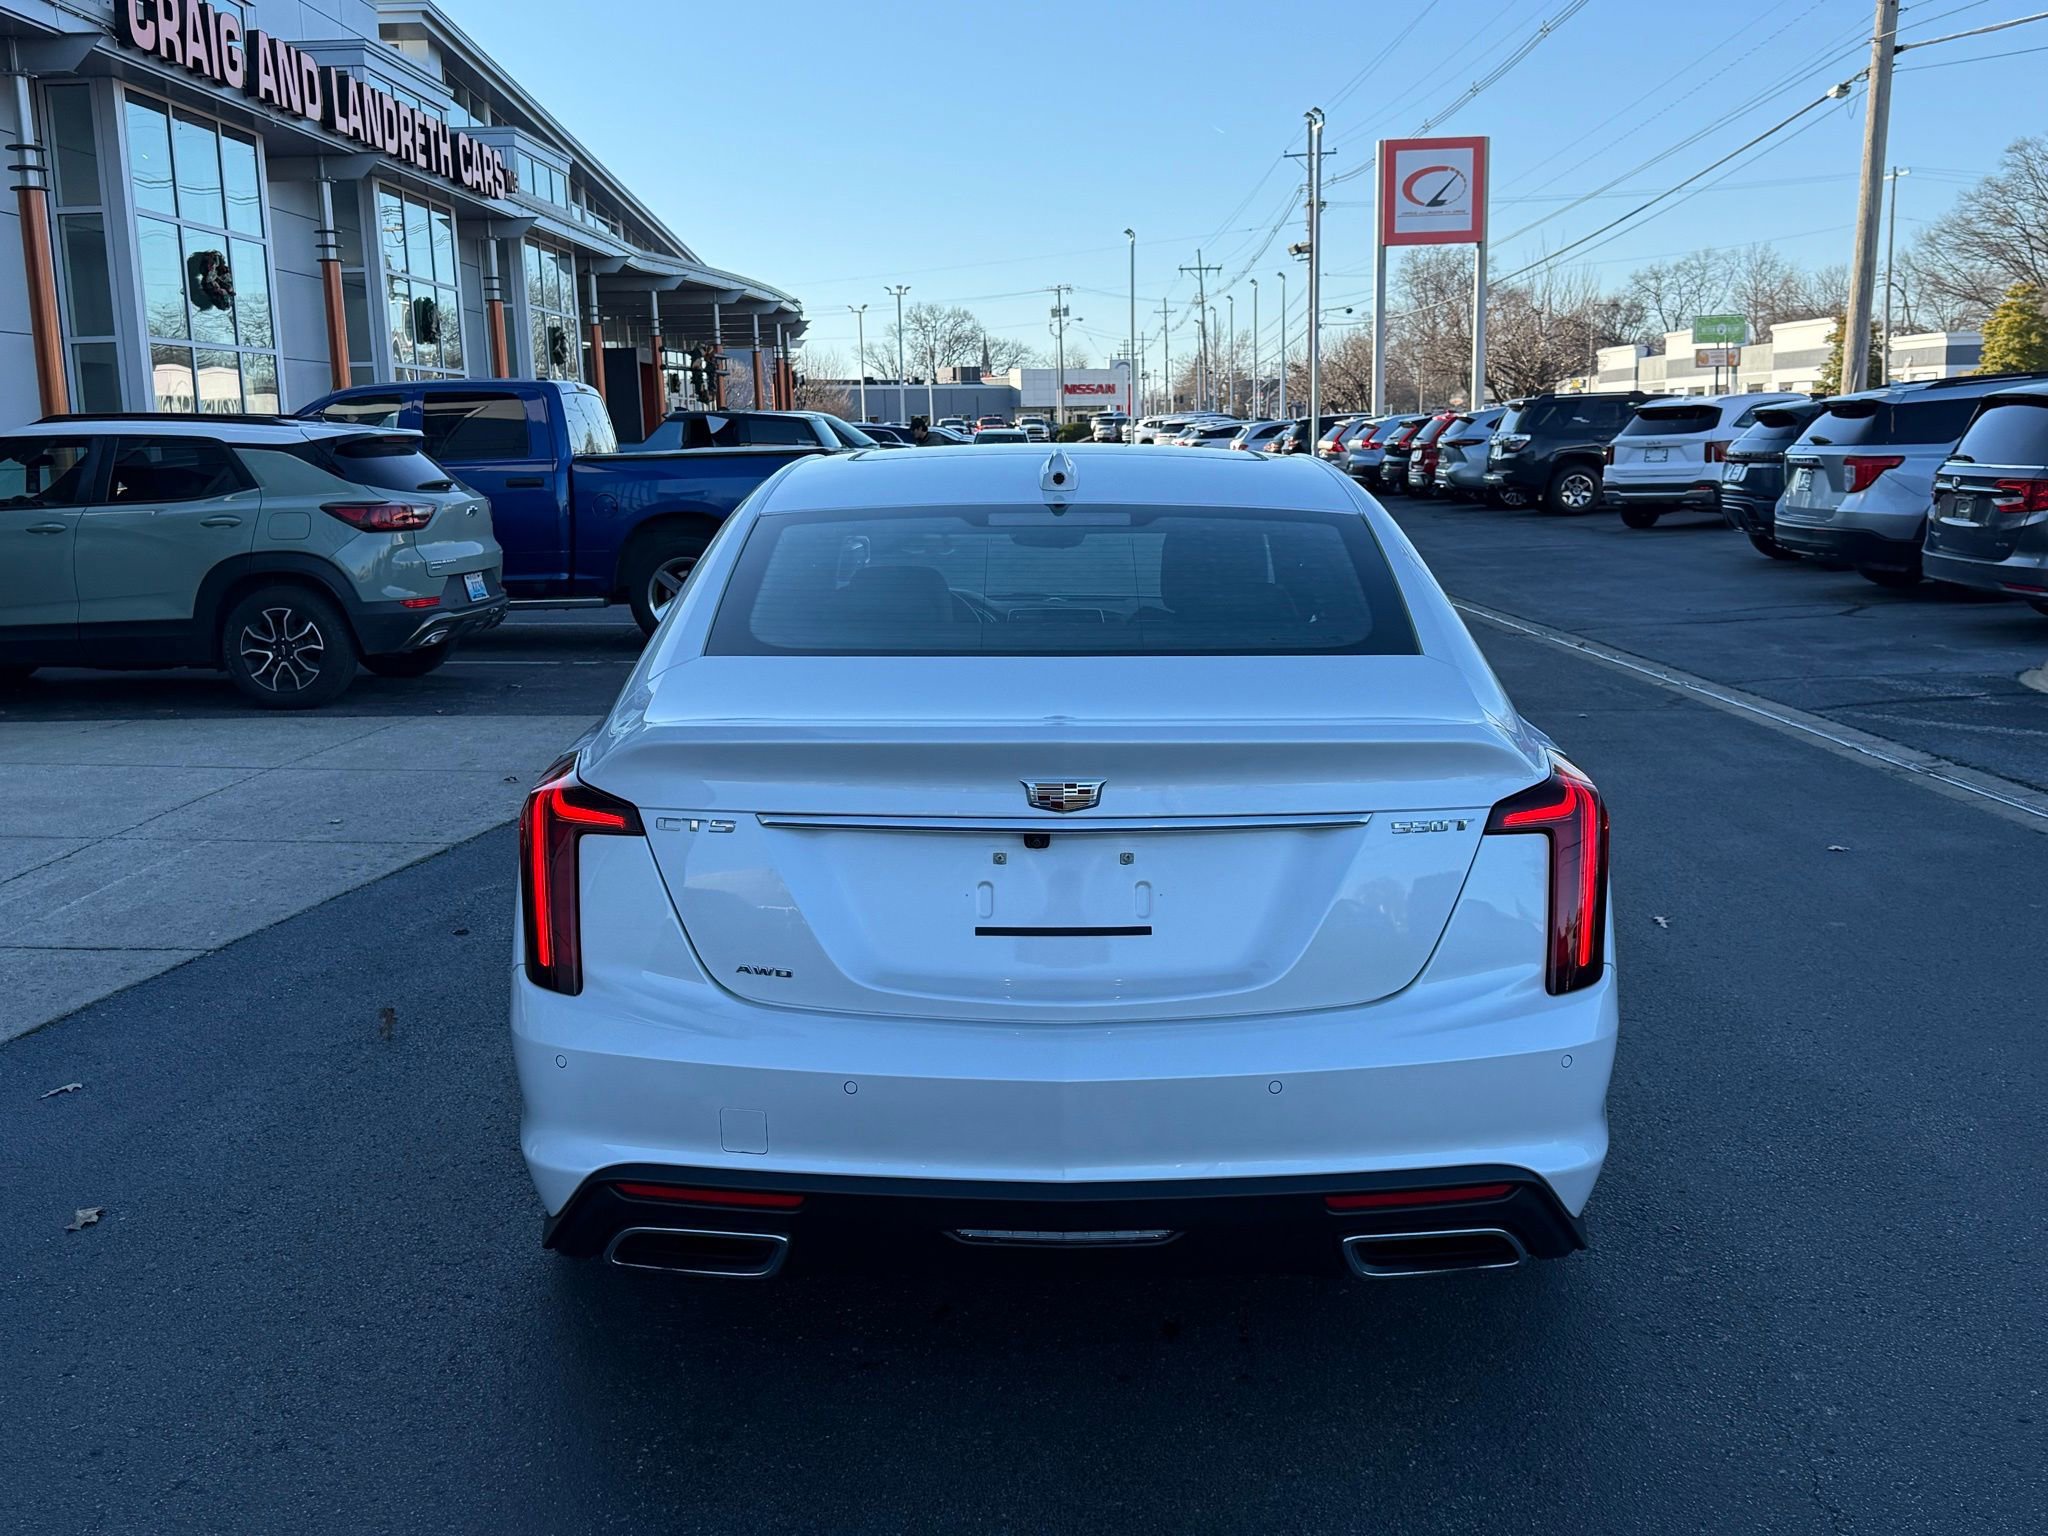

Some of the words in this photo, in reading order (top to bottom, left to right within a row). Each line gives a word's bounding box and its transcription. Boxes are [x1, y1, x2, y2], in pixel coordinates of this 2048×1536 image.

[127, 0, 244, 89] CRAIG
[257, 29, 323, 123] AND
[331, 66, 454, 180] LANDRETH
[458, 132, 506, 200] CARS
[1063, 383, 1116, 395] NISSAN
[736, 964, 793, 978] AWD
